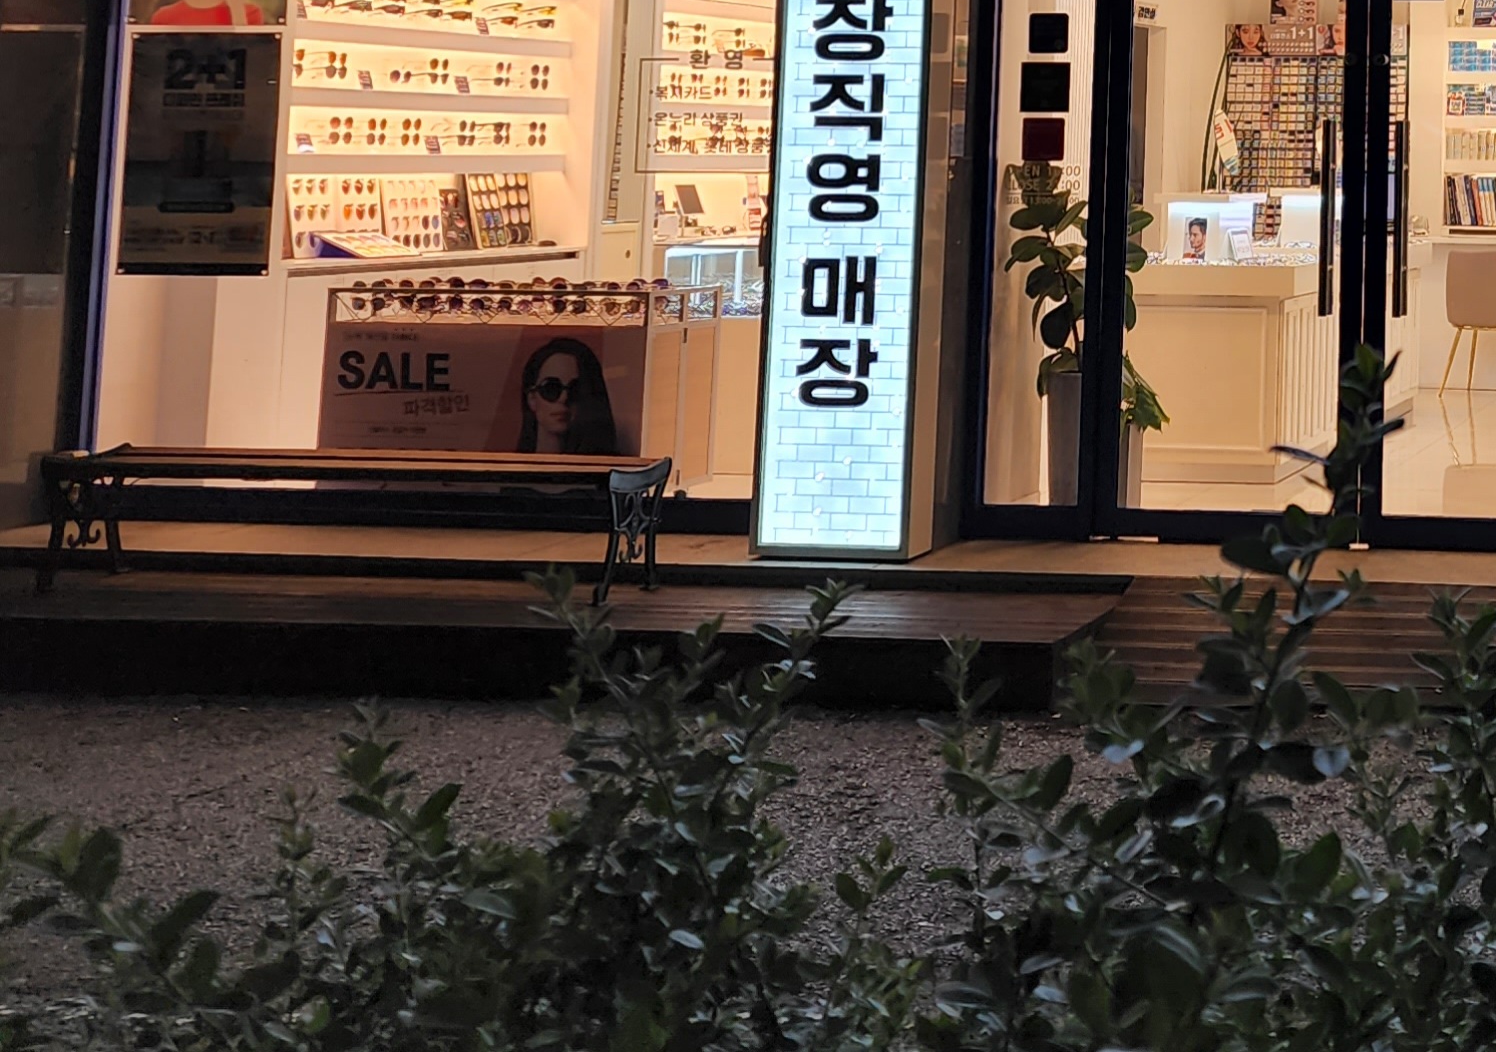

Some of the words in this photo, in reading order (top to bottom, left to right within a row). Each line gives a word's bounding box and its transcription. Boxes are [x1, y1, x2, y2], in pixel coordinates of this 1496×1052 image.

[1290, 26, 1314, 40] 1+1
[655, 86, 713, 100] 복지카드
[654, 112, 697, 126] 온누리
[701, 112, 743, 127] 상품권
[797, 255, 880, 410] 매장
[337, 350, 450, 391] SALE
[404, 394, 470, 416] 파격할인
